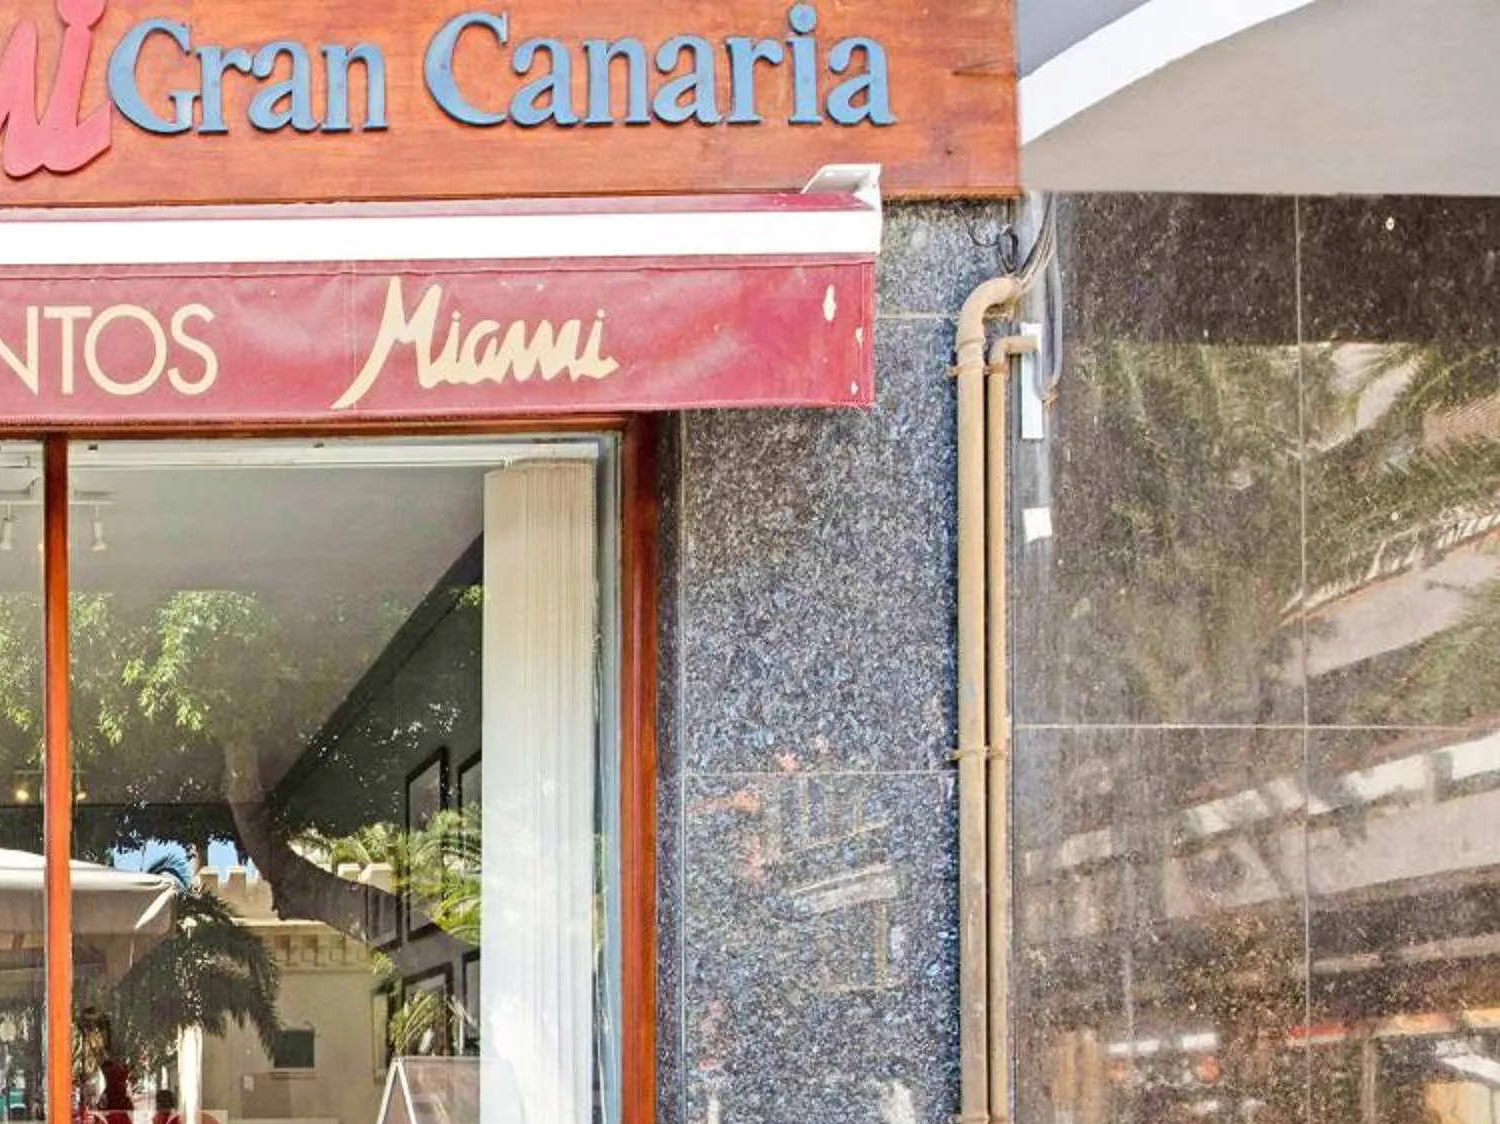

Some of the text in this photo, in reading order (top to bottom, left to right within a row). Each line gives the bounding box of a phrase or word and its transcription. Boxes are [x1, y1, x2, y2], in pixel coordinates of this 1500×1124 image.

[108, 15, 388, 135] Gran
[423, 4, 898, 129] Canaria
[330, 275, 620, 409] Miami
